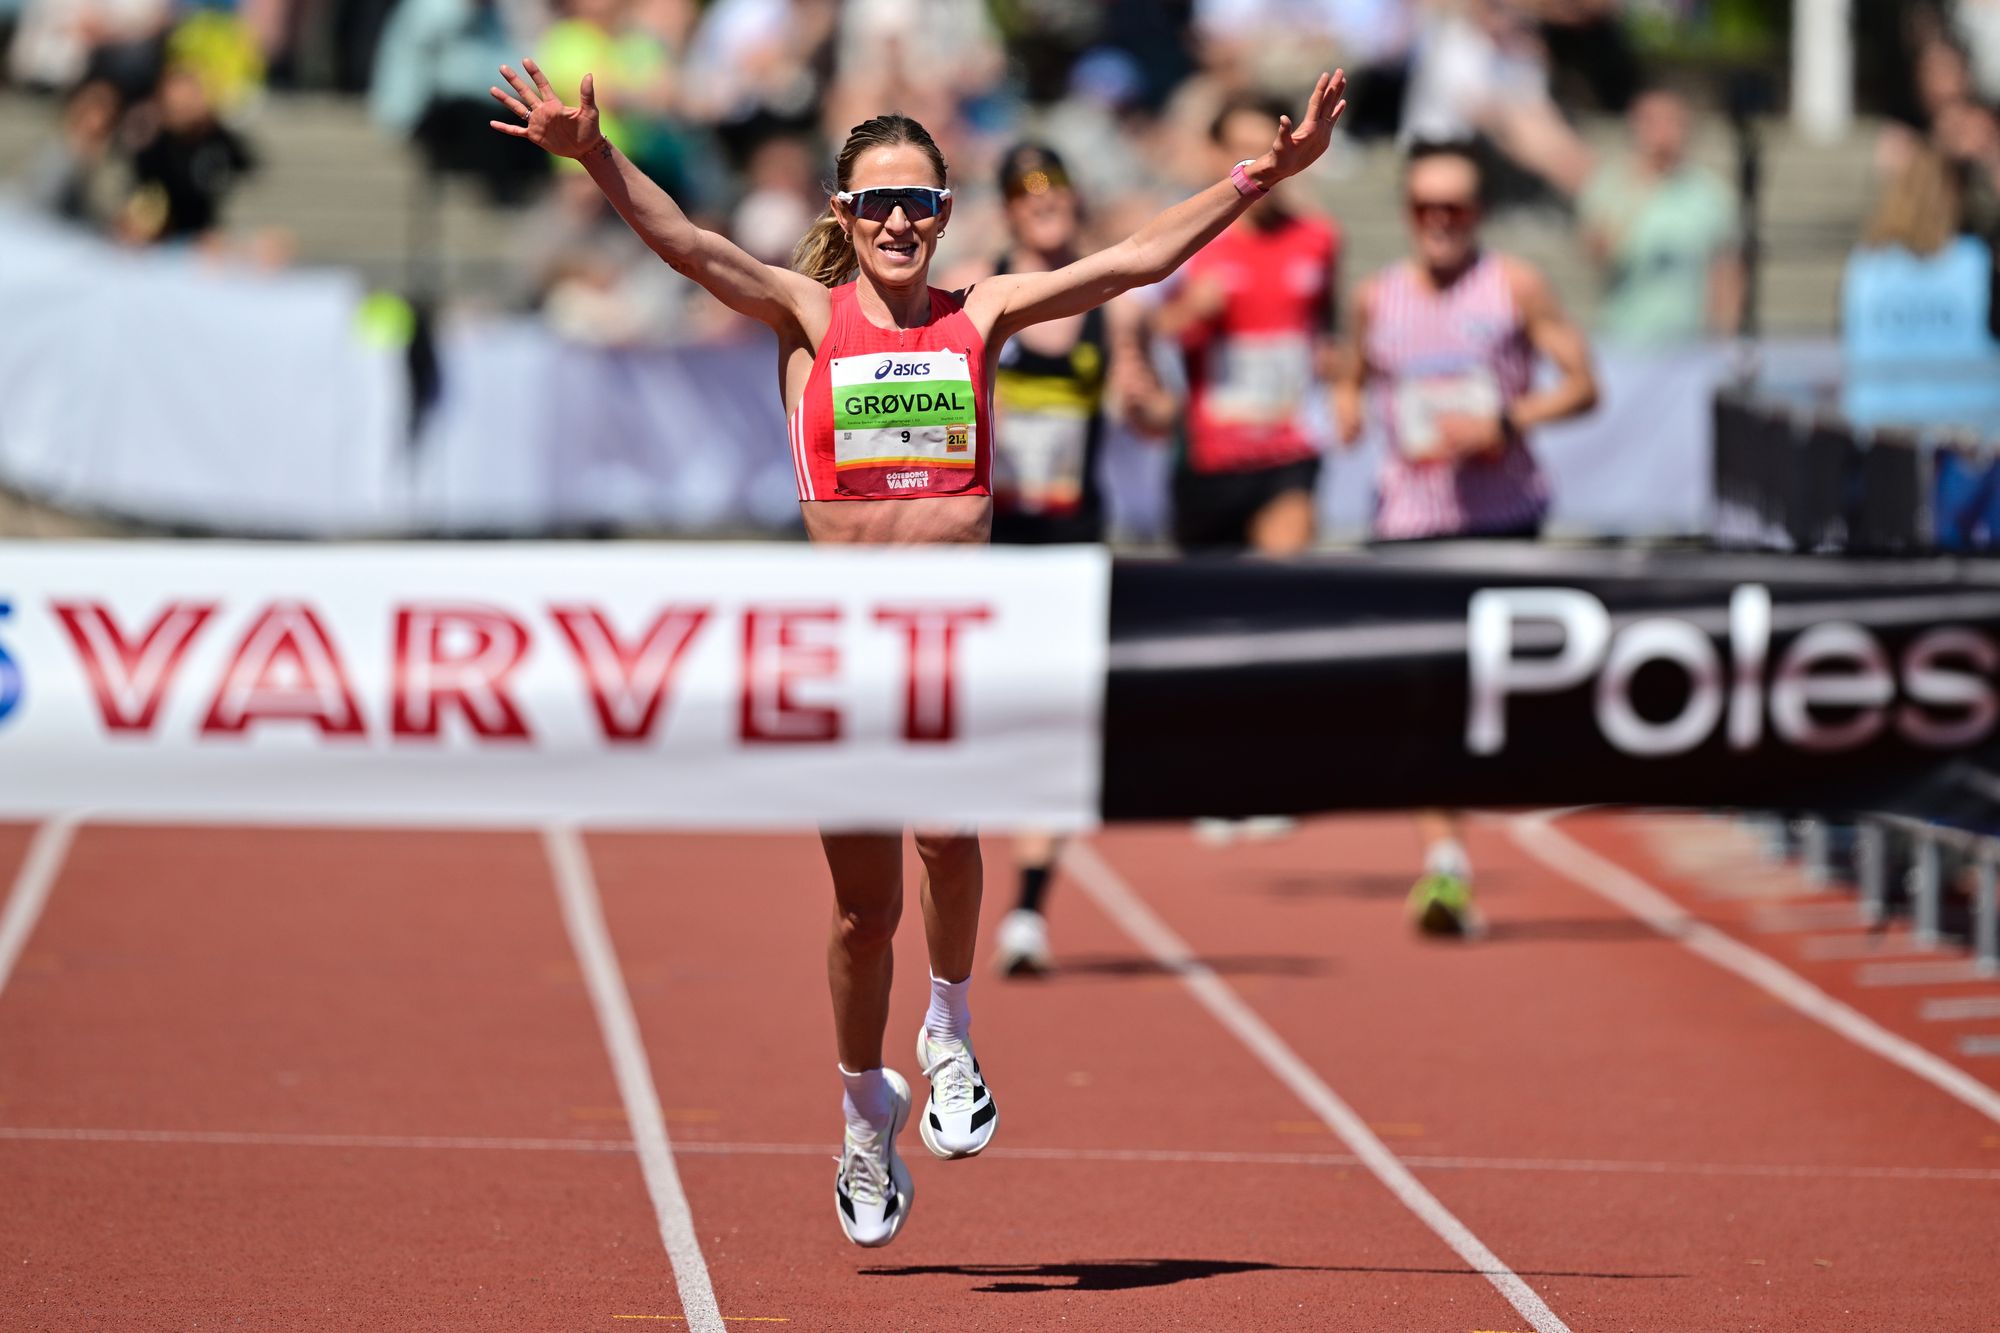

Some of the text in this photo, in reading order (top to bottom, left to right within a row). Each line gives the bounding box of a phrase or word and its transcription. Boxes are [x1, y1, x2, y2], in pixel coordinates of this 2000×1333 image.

[845, 392, 965, 416] GRØVDAL
[901, 430, 911, 443] 9
[887, 478, 928, 489] VARVET
[49, 600, 992, 743] VARVET
[1466, 583, 2000, 757] Poles
